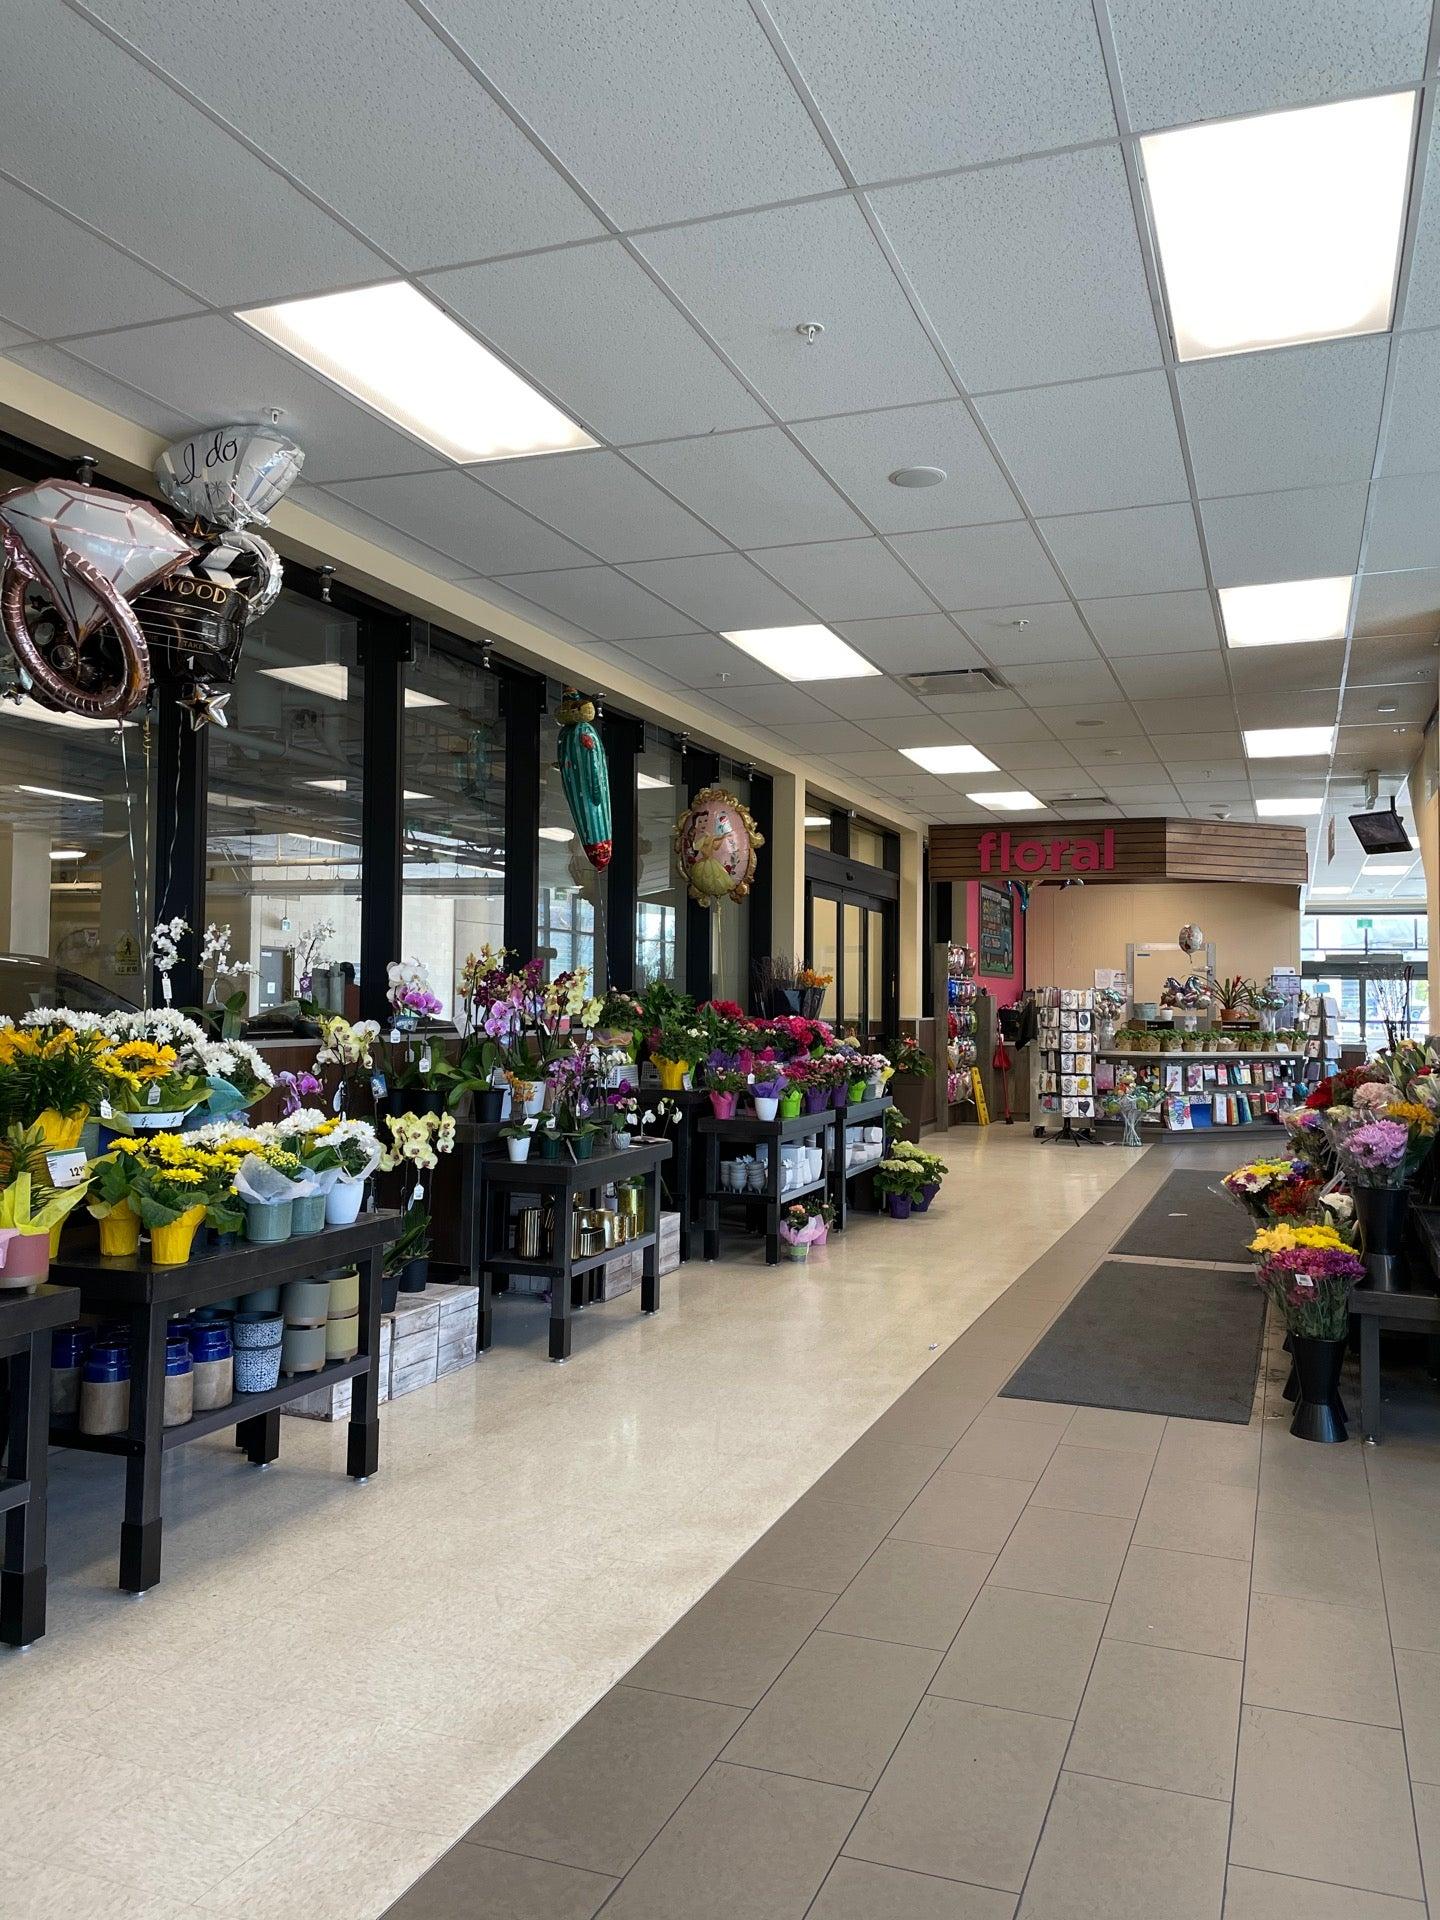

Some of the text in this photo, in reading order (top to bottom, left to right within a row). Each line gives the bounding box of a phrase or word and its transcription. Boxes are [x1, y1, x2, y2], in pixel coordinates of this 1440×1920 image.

[180, 431, 237, 484] I do
[183, 640, 204, 651] TAKE
[186, 655, 195, 670] 1
[977, 828, 1116, 873] floral
